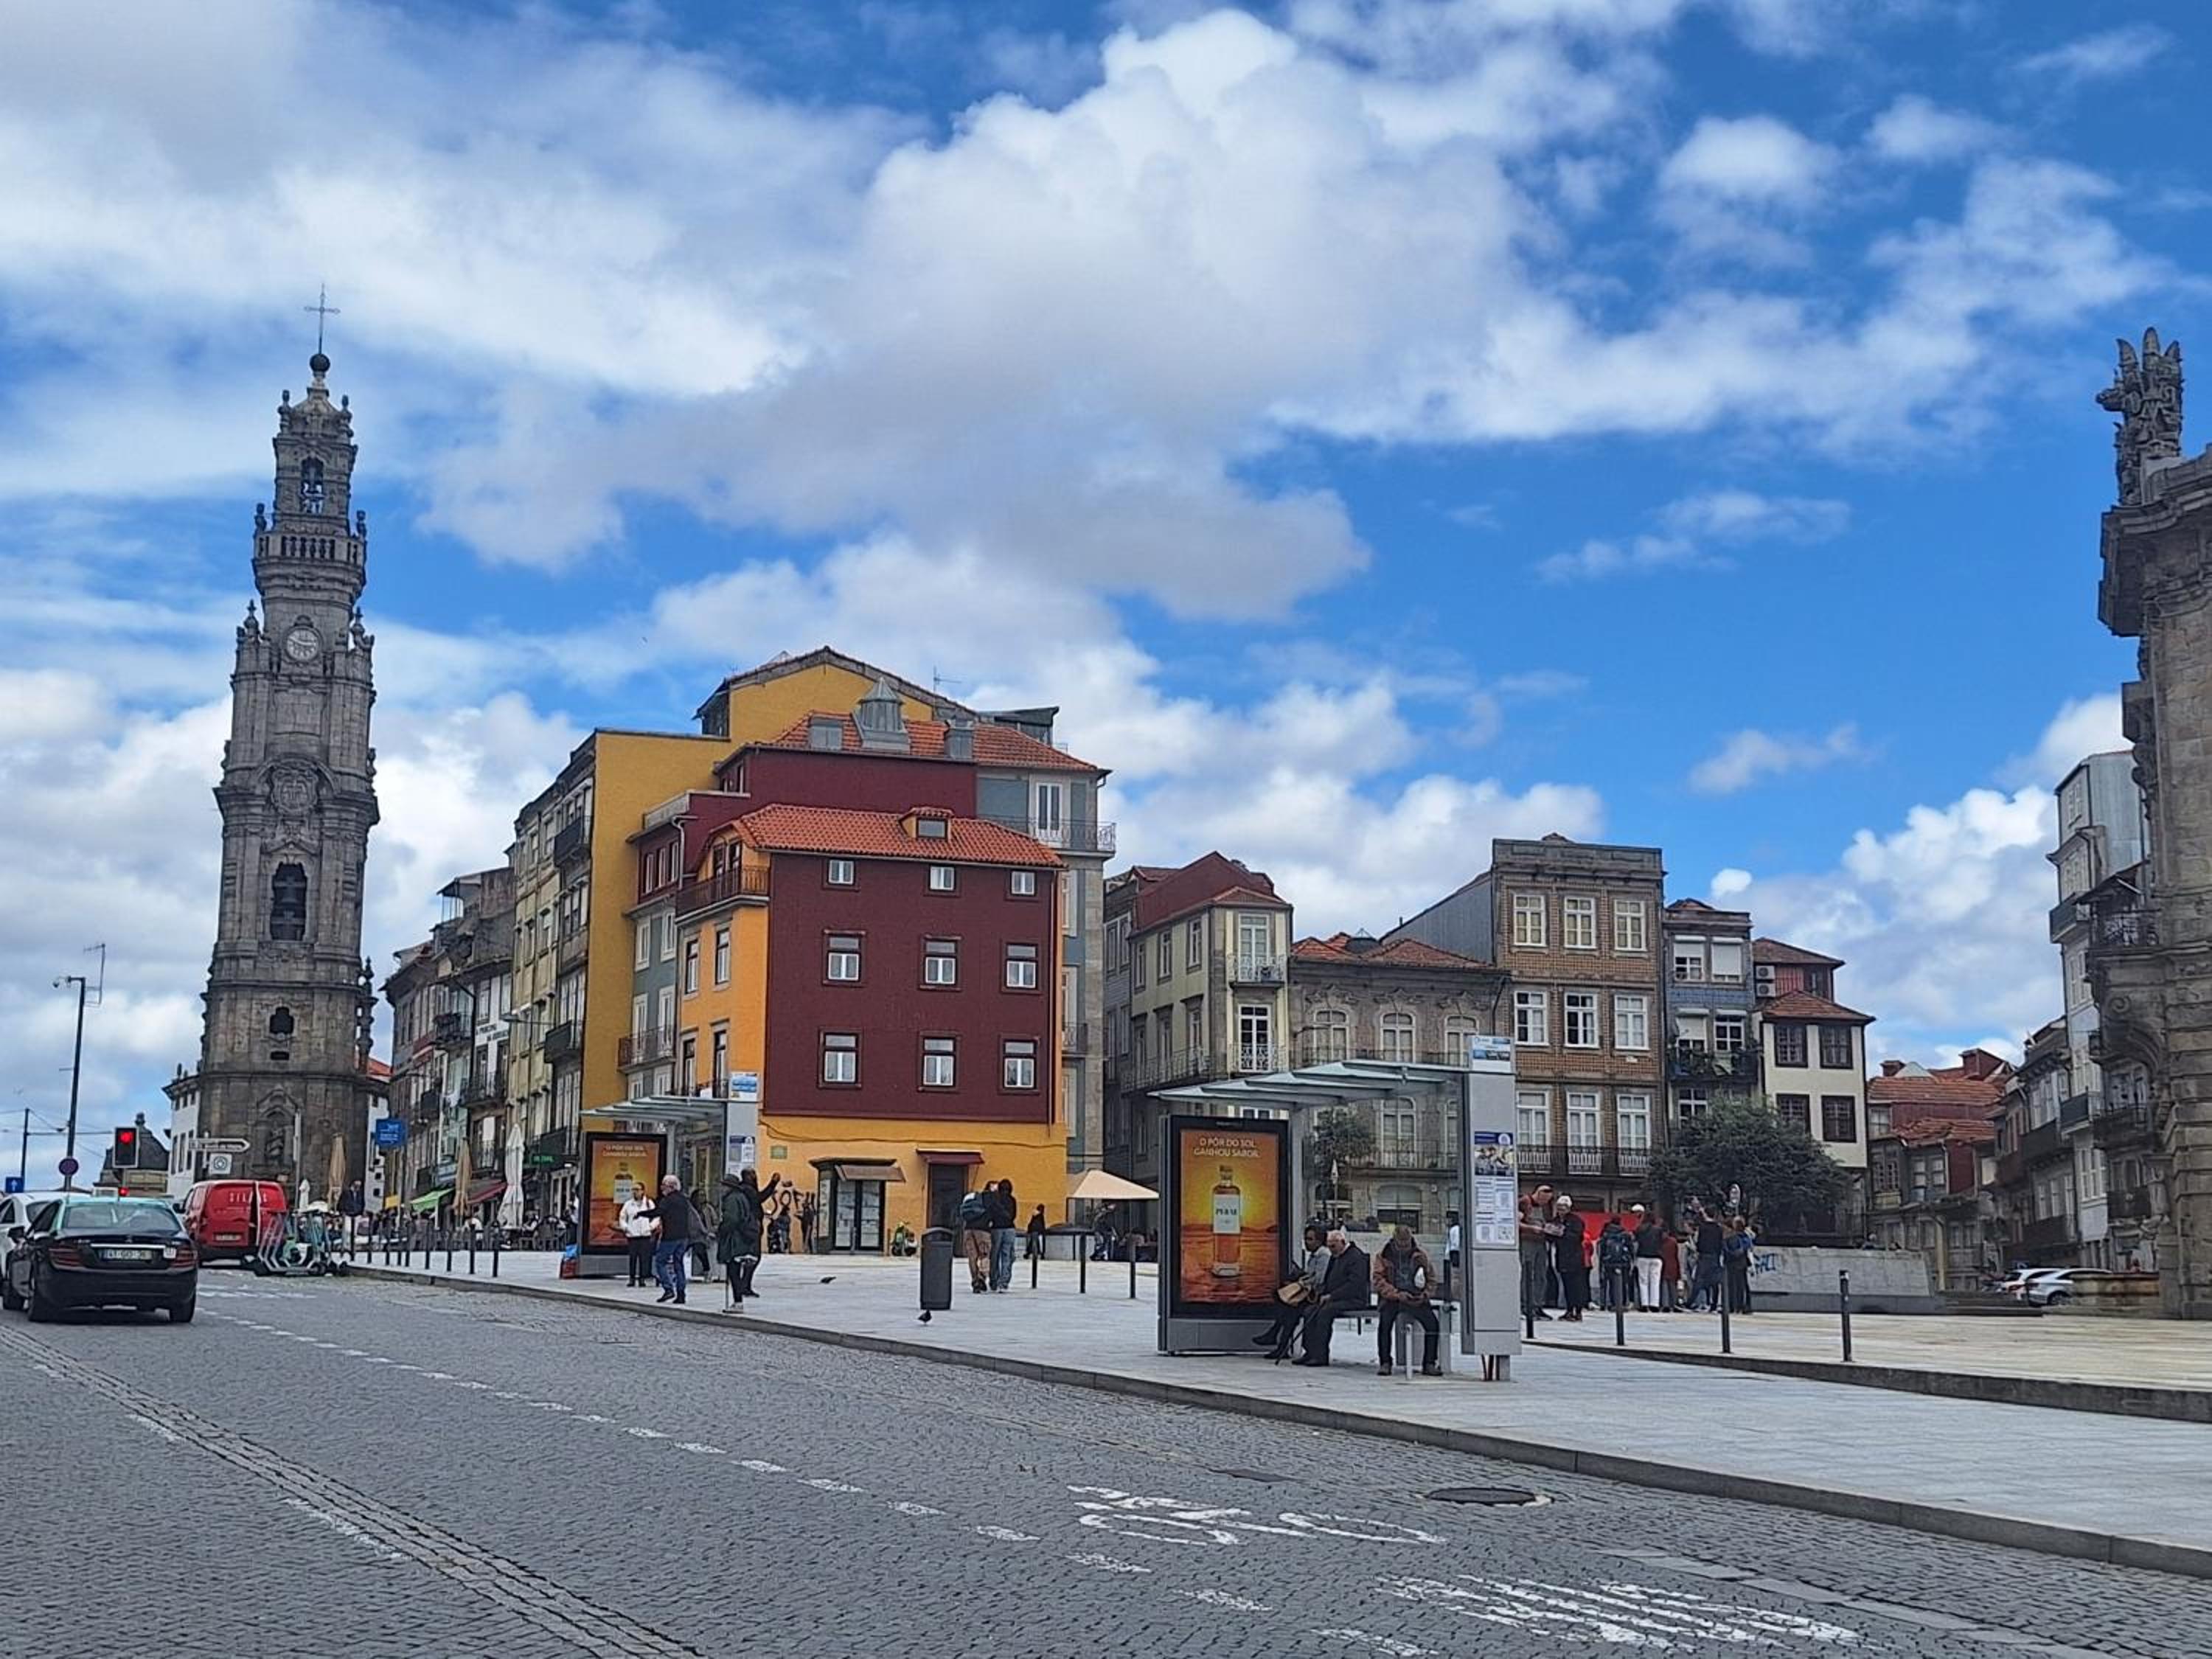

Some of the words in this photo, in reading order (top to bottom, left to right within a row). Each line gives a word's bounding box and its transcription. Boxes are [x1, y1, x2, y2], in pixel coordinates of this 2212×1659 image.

[1200, 1138, 1206, 1146] O
[1208, 1136, 1225, 1146] PÔR
[1227, 1138, 1239, 1147] DO
